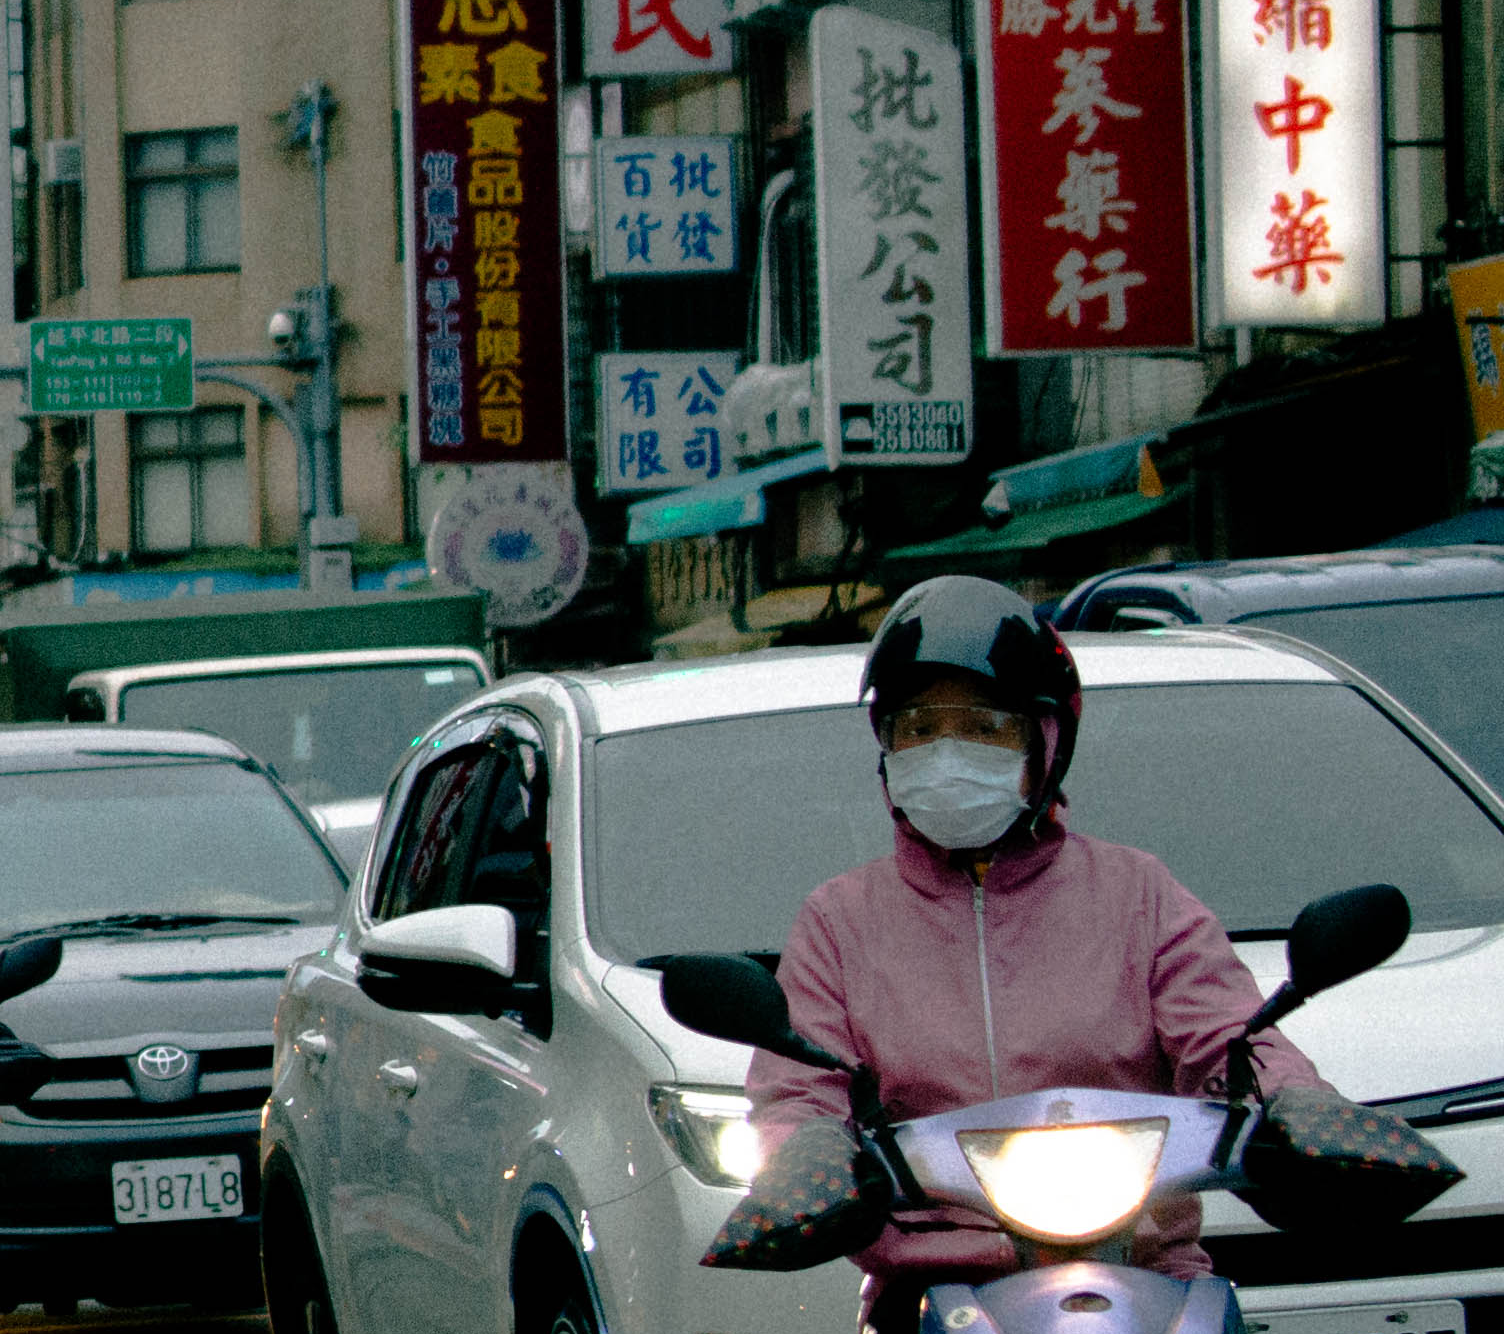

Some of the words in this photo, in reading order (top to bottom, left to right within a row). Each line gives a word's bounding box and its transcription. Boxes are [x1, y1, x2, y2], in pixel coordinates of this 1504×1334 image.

[419, 40, 548, 108] 素食
[850, 48, 942, 396] 批發公司
